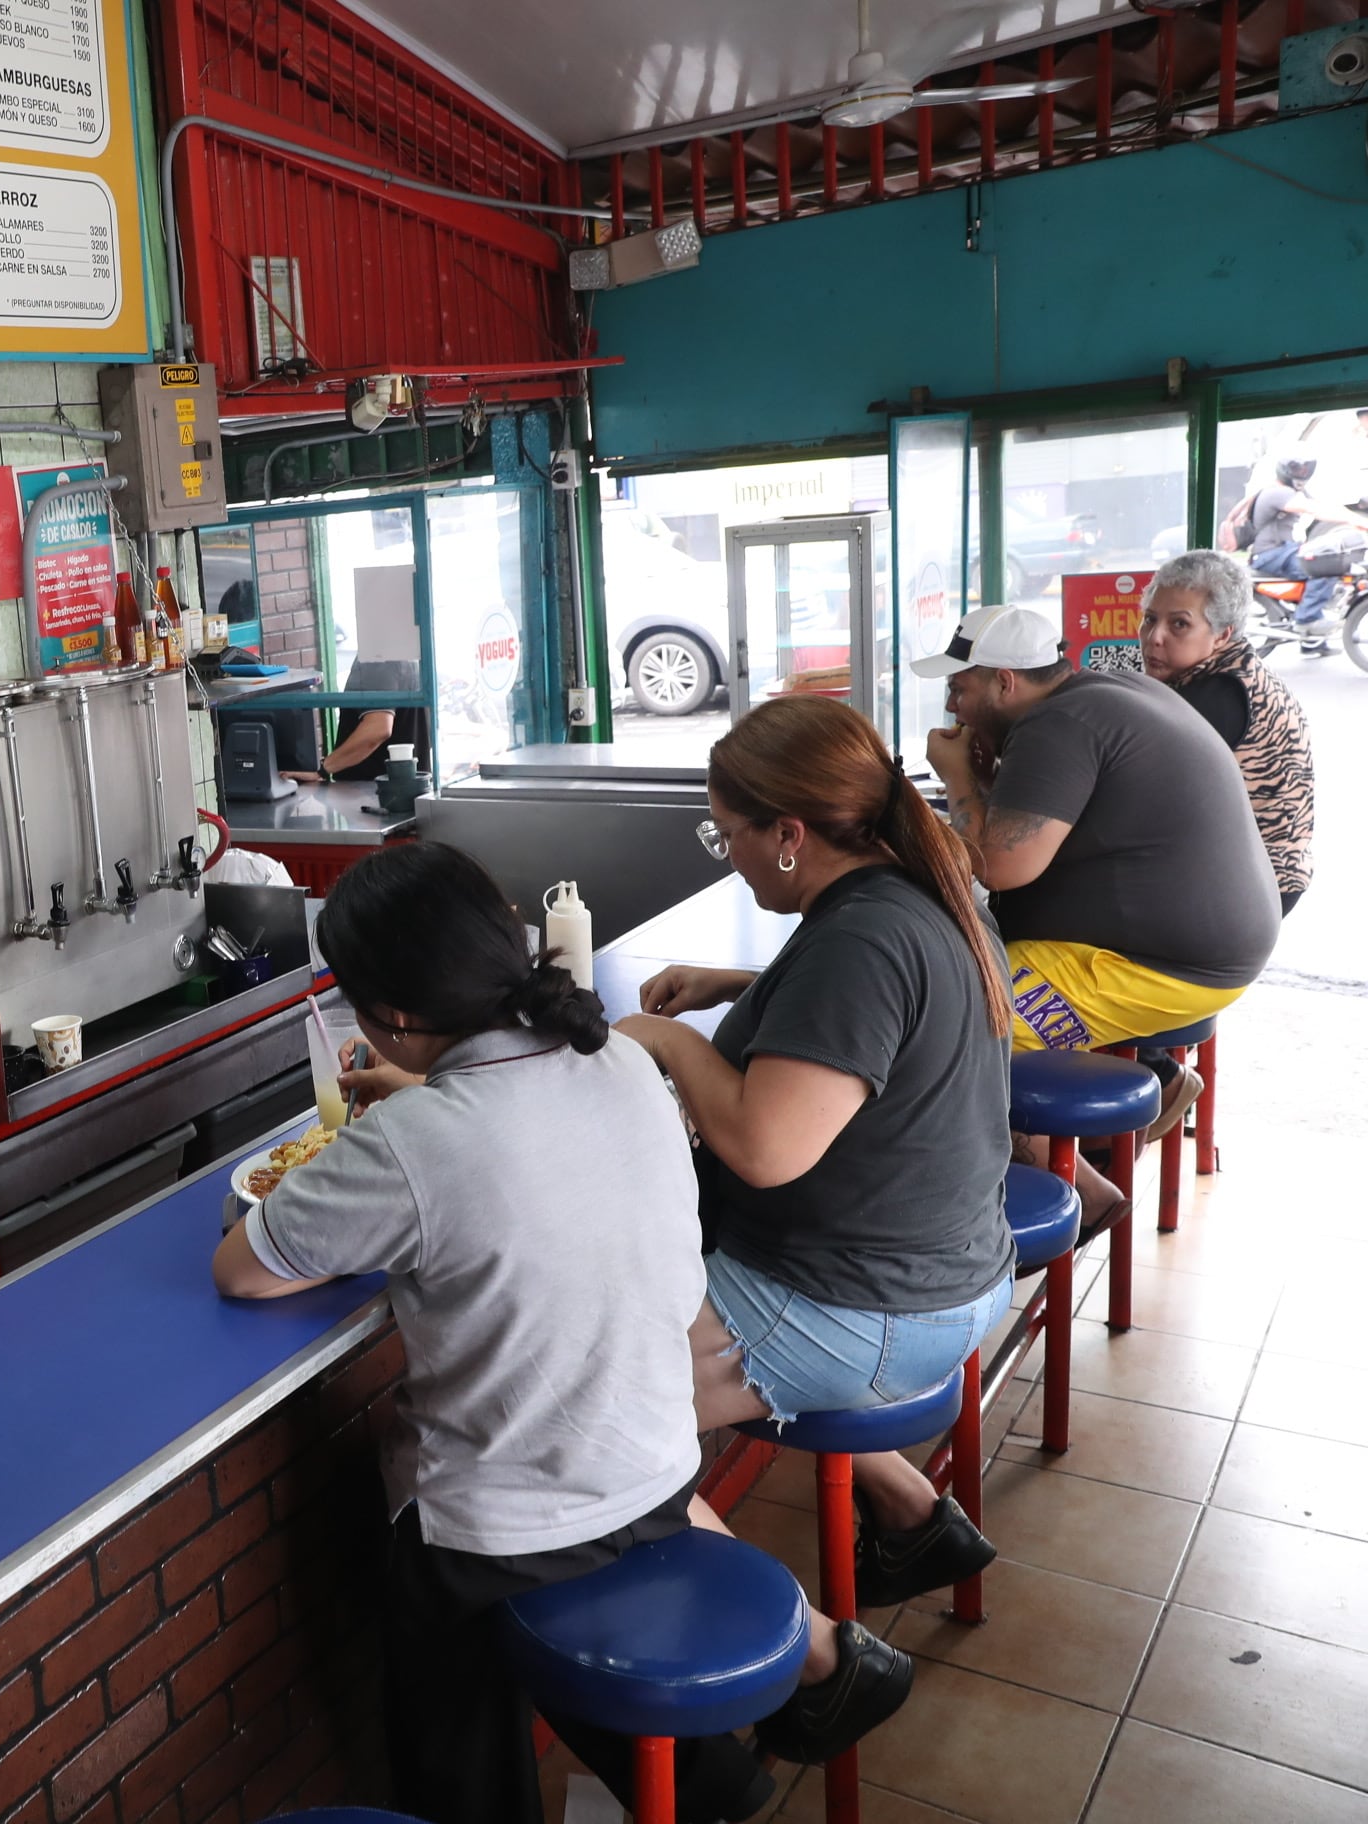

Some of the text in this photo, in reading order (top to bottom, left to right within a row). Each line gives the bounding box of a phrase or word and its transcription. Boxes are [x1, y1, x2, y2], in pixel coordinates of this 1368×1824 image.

[14, 21, 49, 39] BLANCO
[72, 34, 90, 48] 1700
[71, 20, 89, 33] 1900
[73, 49, 91, 62] 1500
[21, 97, 62, 114] ESPECIAL
[77, 106, 95, 119] 3100
[20, 112, 26, 123] Y
[28, 113, 58, 127] QUESO
[78, 121, 96, 133] 1600
[90, 225, 107, 237] 3200
[92, 254, 109, 265] 3200
[27, 263, 39, 275] EN
[40, 264, 67, 276] SALSA
[93, 267, 110, 279] 2700
[166, 370, 194, 381] PELIGRO
[734, 471, 823, 507] Imperial
[47, 521, 91, 544] DE CASADO
[38, 570, 63, 581] Chuleta
[68, 567, 84, 577] Pollo
[93, 563, 108, 573] salsa
[40, 582, 66, 594] Pescado
[69, 579, 87, 589] Carne
[1090, 608, 1144, 637] MEN
[478, 637, 515, 668] YOGUIS
